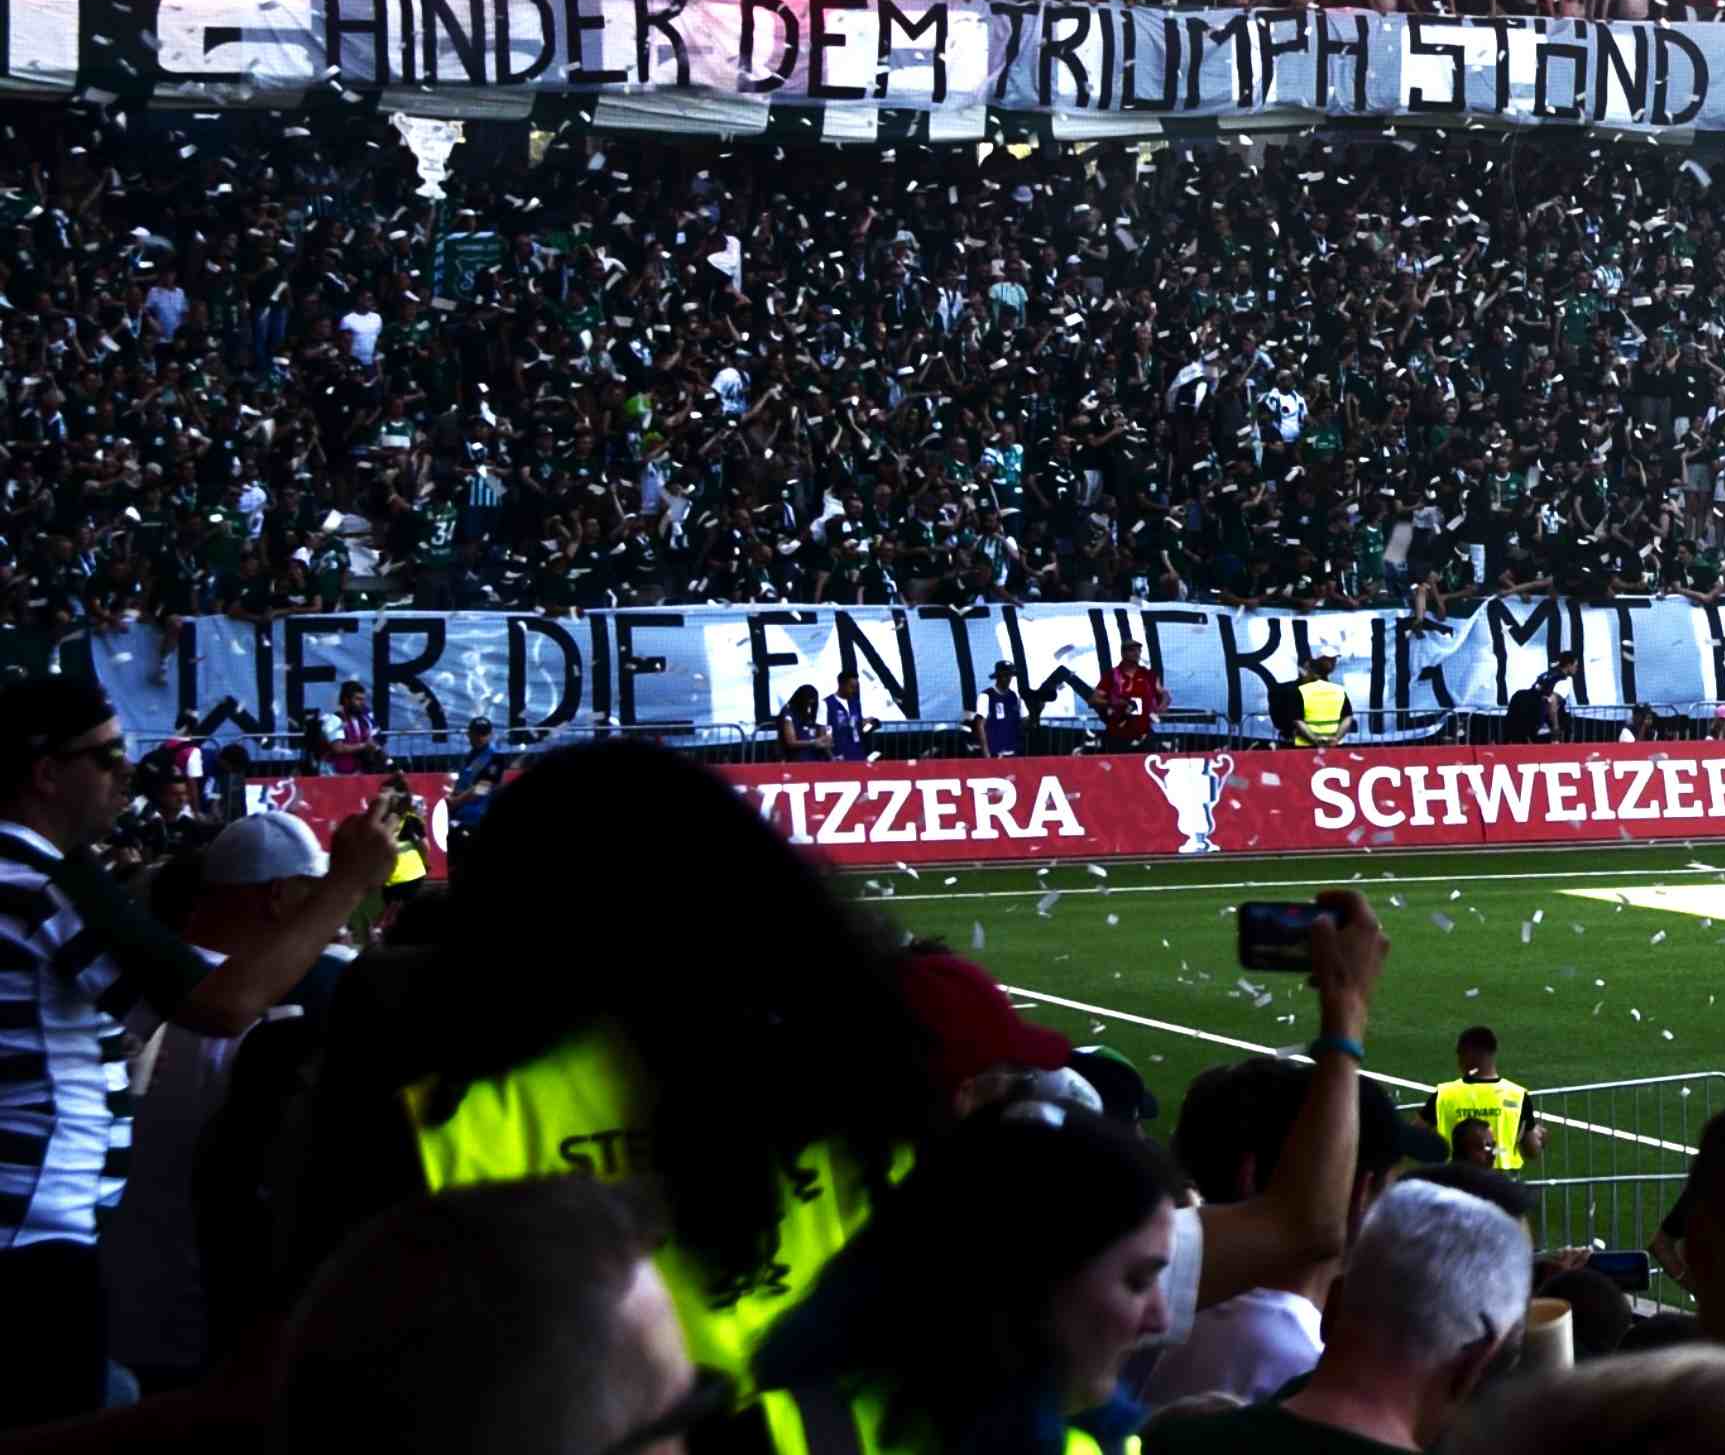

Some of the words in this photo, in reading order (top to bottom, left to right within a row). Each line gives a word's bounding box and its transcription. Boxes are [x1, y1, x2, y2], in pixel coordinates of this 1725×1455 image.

[990, 1, 1370, 113] TRIUMPH
[176, 614, 449, 750] WER
[507, 610, 697, 744] DIE
[1486, 596, 1652, 707] MIT
